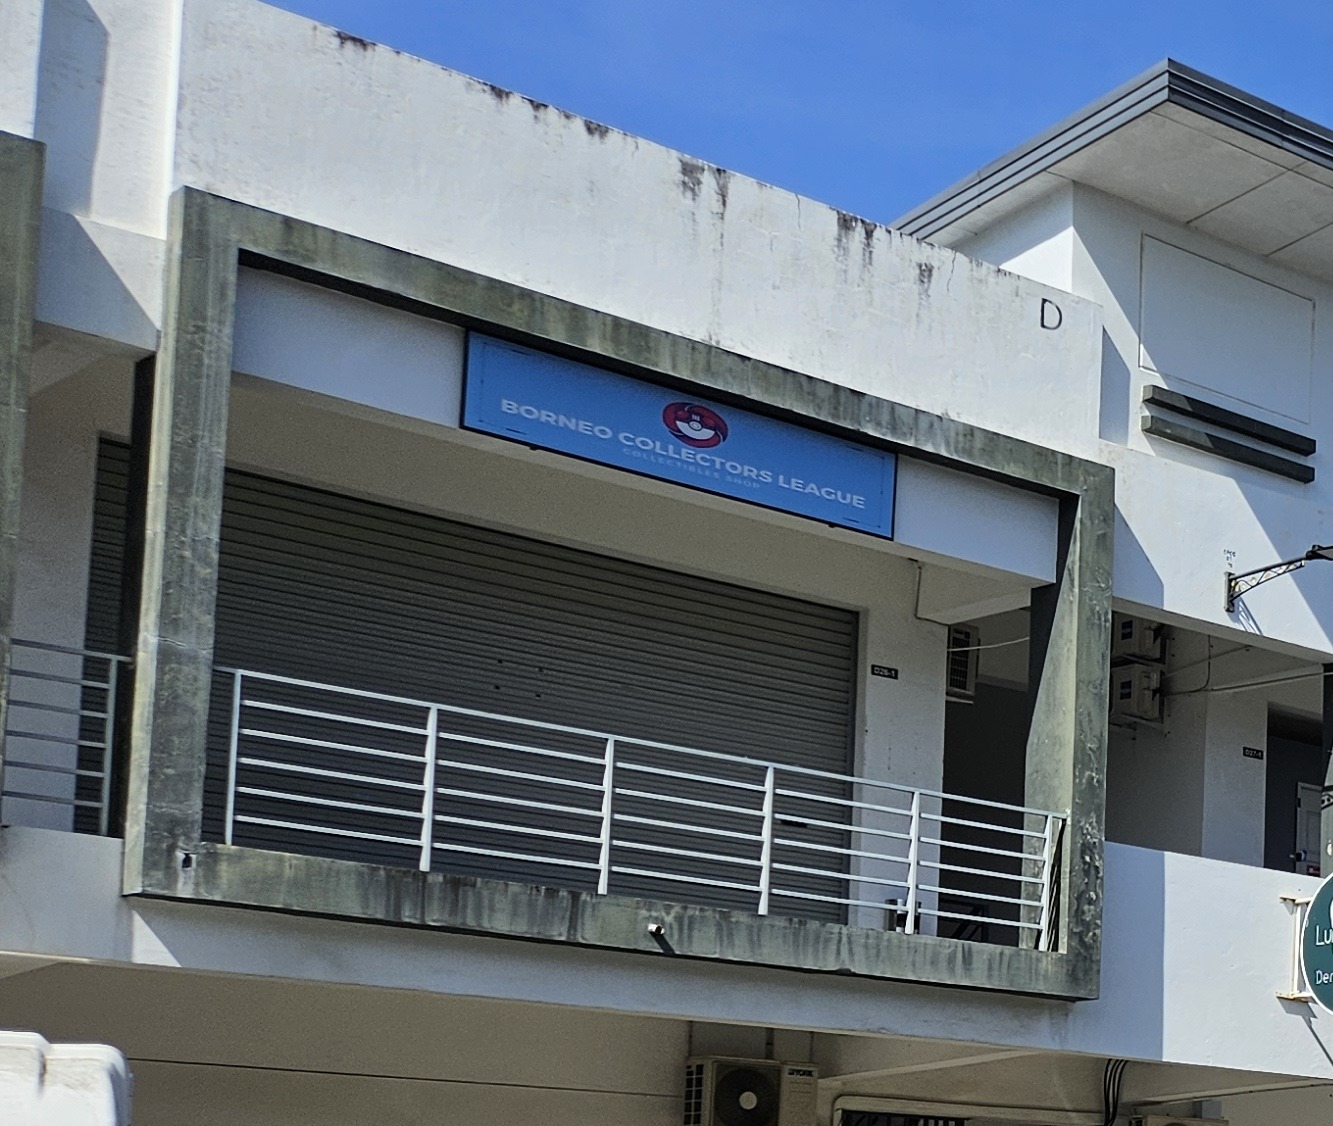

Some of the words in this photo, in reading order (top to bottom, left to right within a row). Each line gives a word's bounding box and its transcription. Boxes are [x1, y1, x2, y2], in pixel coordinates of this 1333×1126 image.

[501, 399, 613, 440] BORNEO
[619, 431, 774, 484] COLLECTORS
[778, 474, 867, 510] LEAGUE
[725, 474, 762, 491] SHOP
